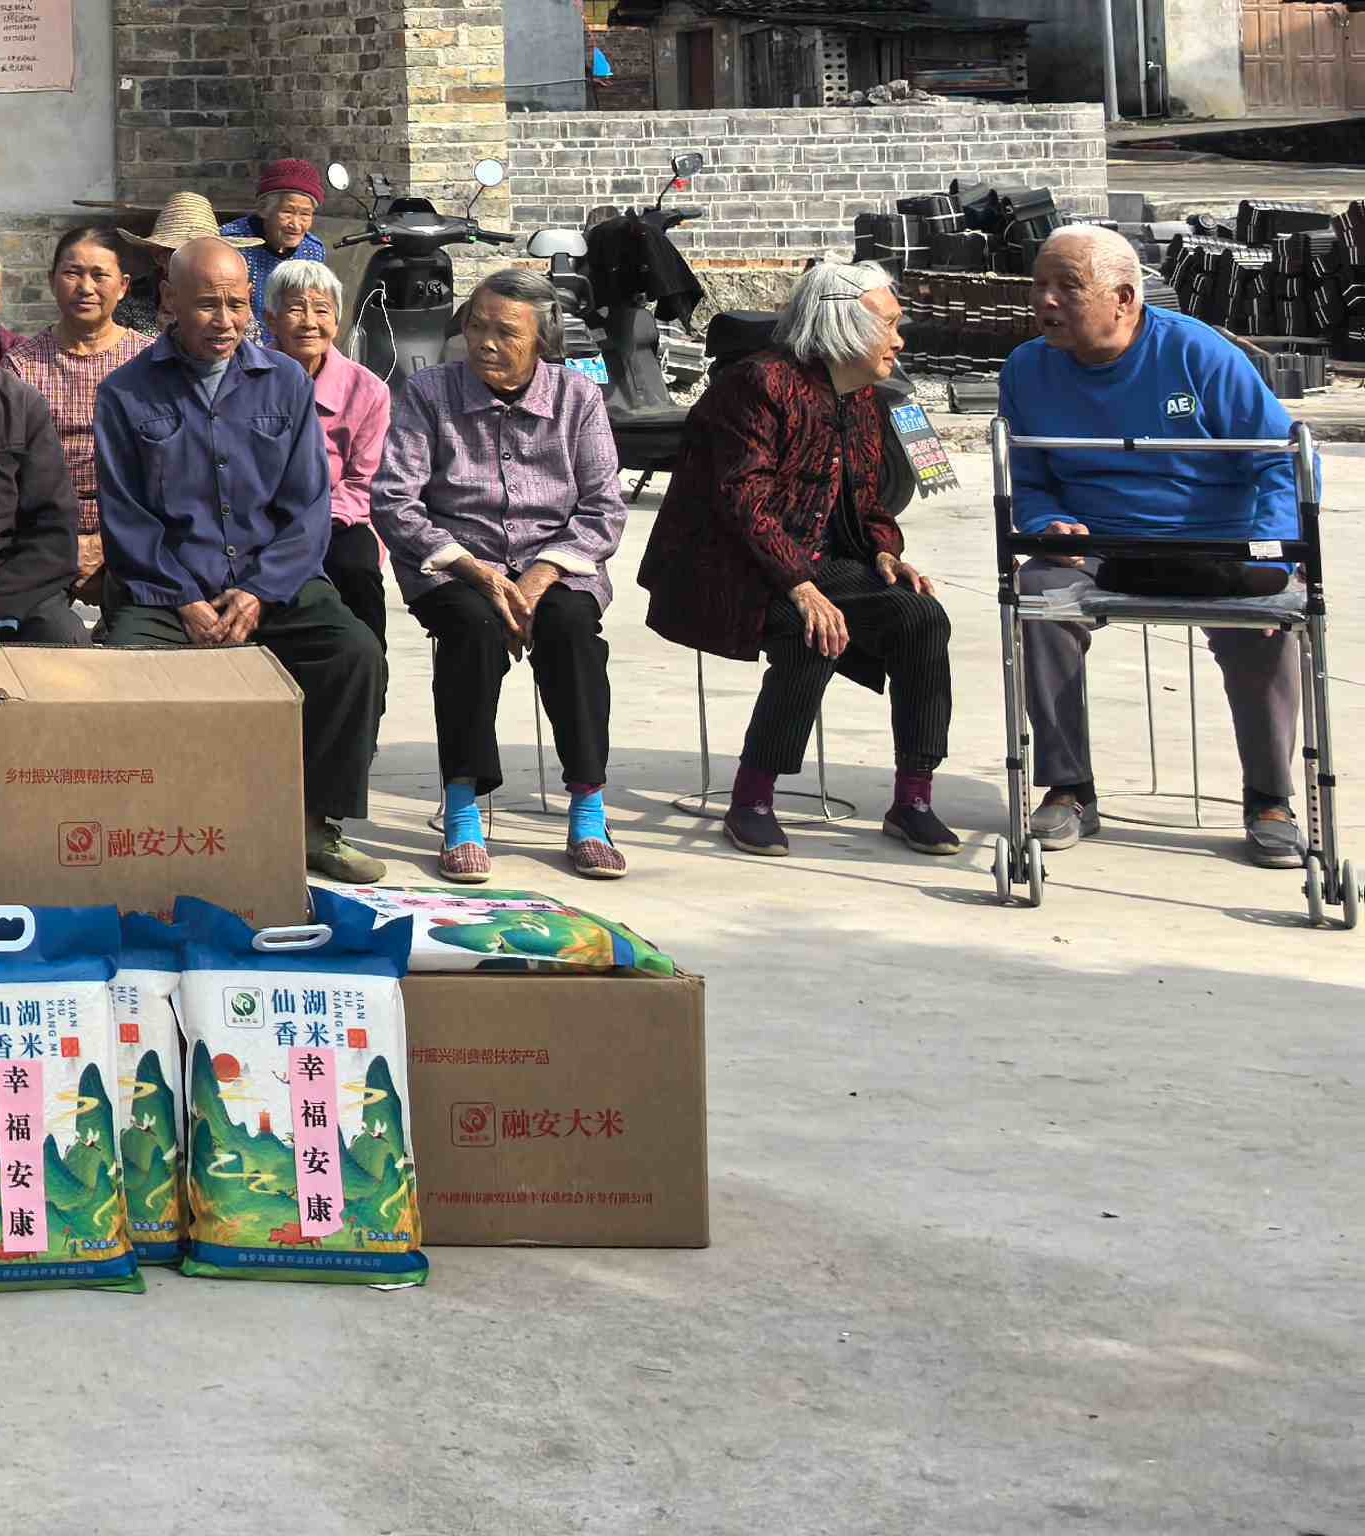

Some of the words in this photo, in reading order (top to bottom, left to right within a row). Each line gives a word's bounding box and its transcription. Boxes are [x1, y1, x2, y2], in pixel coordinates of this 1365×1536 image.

[5, 768, 154, 784] 乡村振兴消费帮扶农产品
[107, 826, 226, 857] 融安大米
[271, 989, 326, 1014] 仙湖
[274, 1021, 329, 1047] 香米
[297, 1054, 333, 1222] 幸福安康
[501, 1108, 623, 1138] 融安大米
[3, 1066, 34, 1236] 幸福安康
